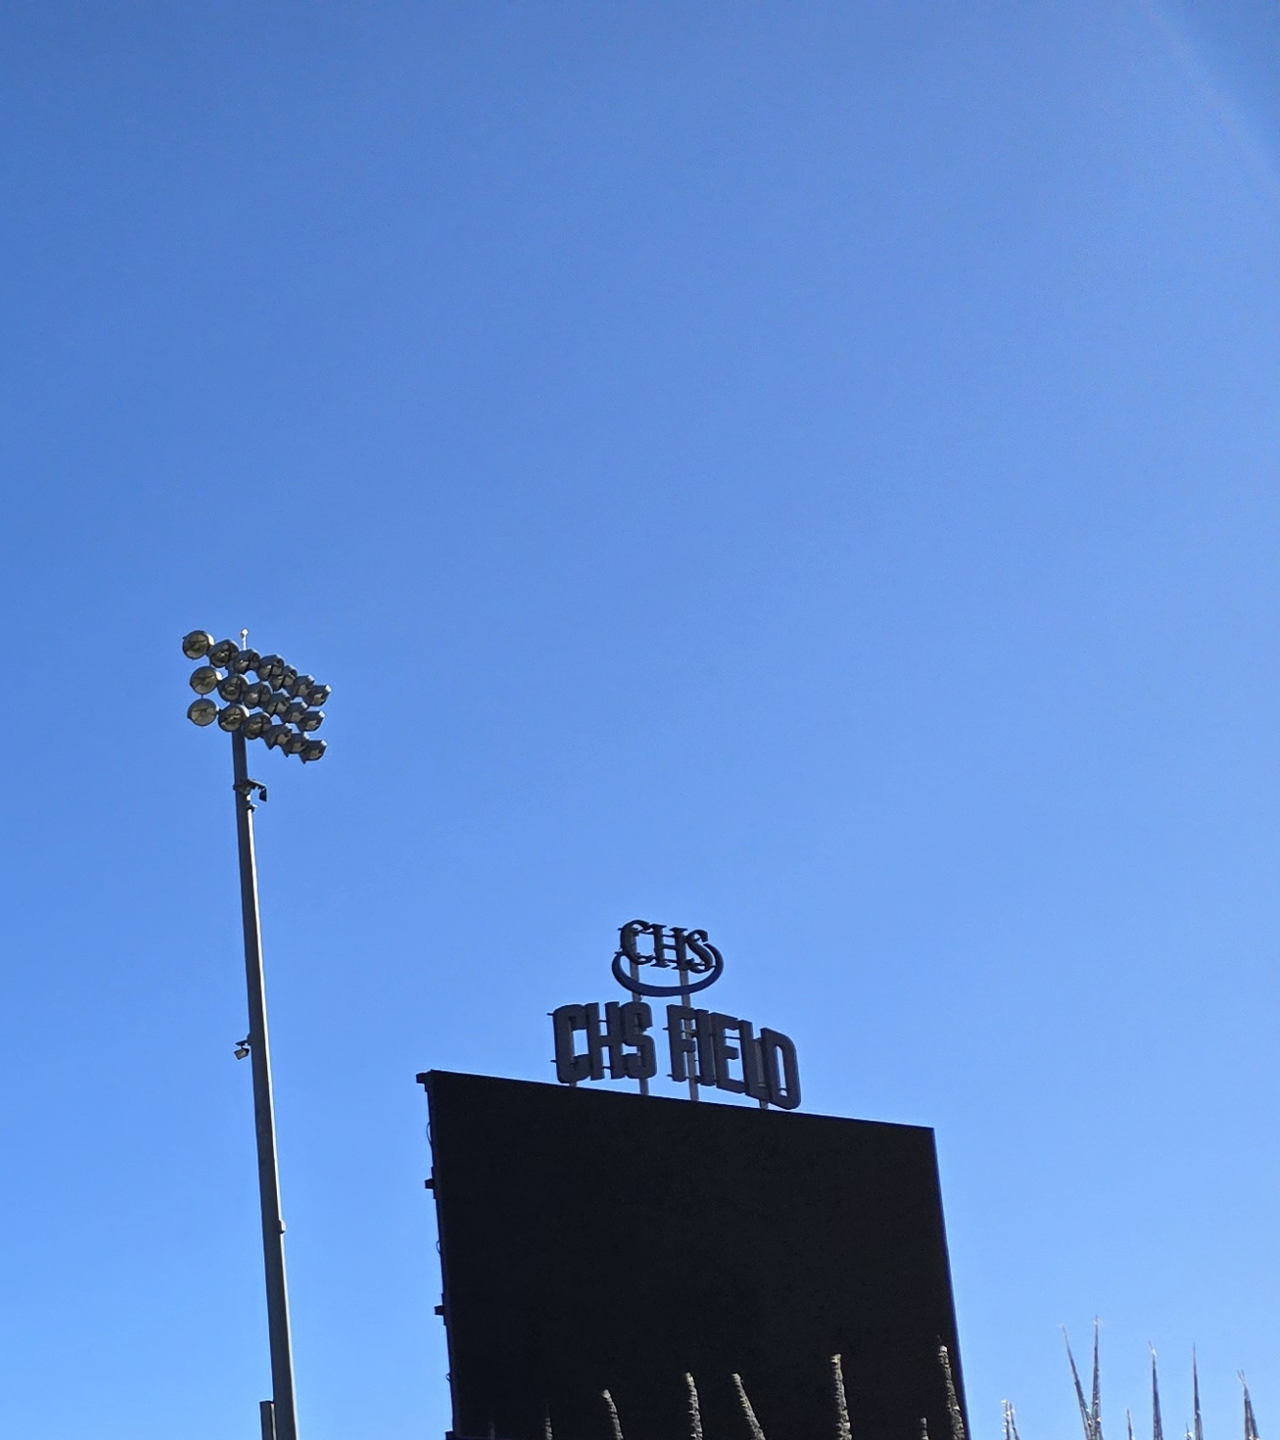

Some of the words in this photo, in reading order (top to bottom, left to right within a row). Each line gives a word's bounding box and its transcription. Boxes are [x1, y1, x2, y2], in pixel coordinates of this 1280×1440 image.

[616, 919, 718, 976] CHS
[551, 1000, 658, 1085] CHS
[665, 1003, 803, 1111] FIELD
